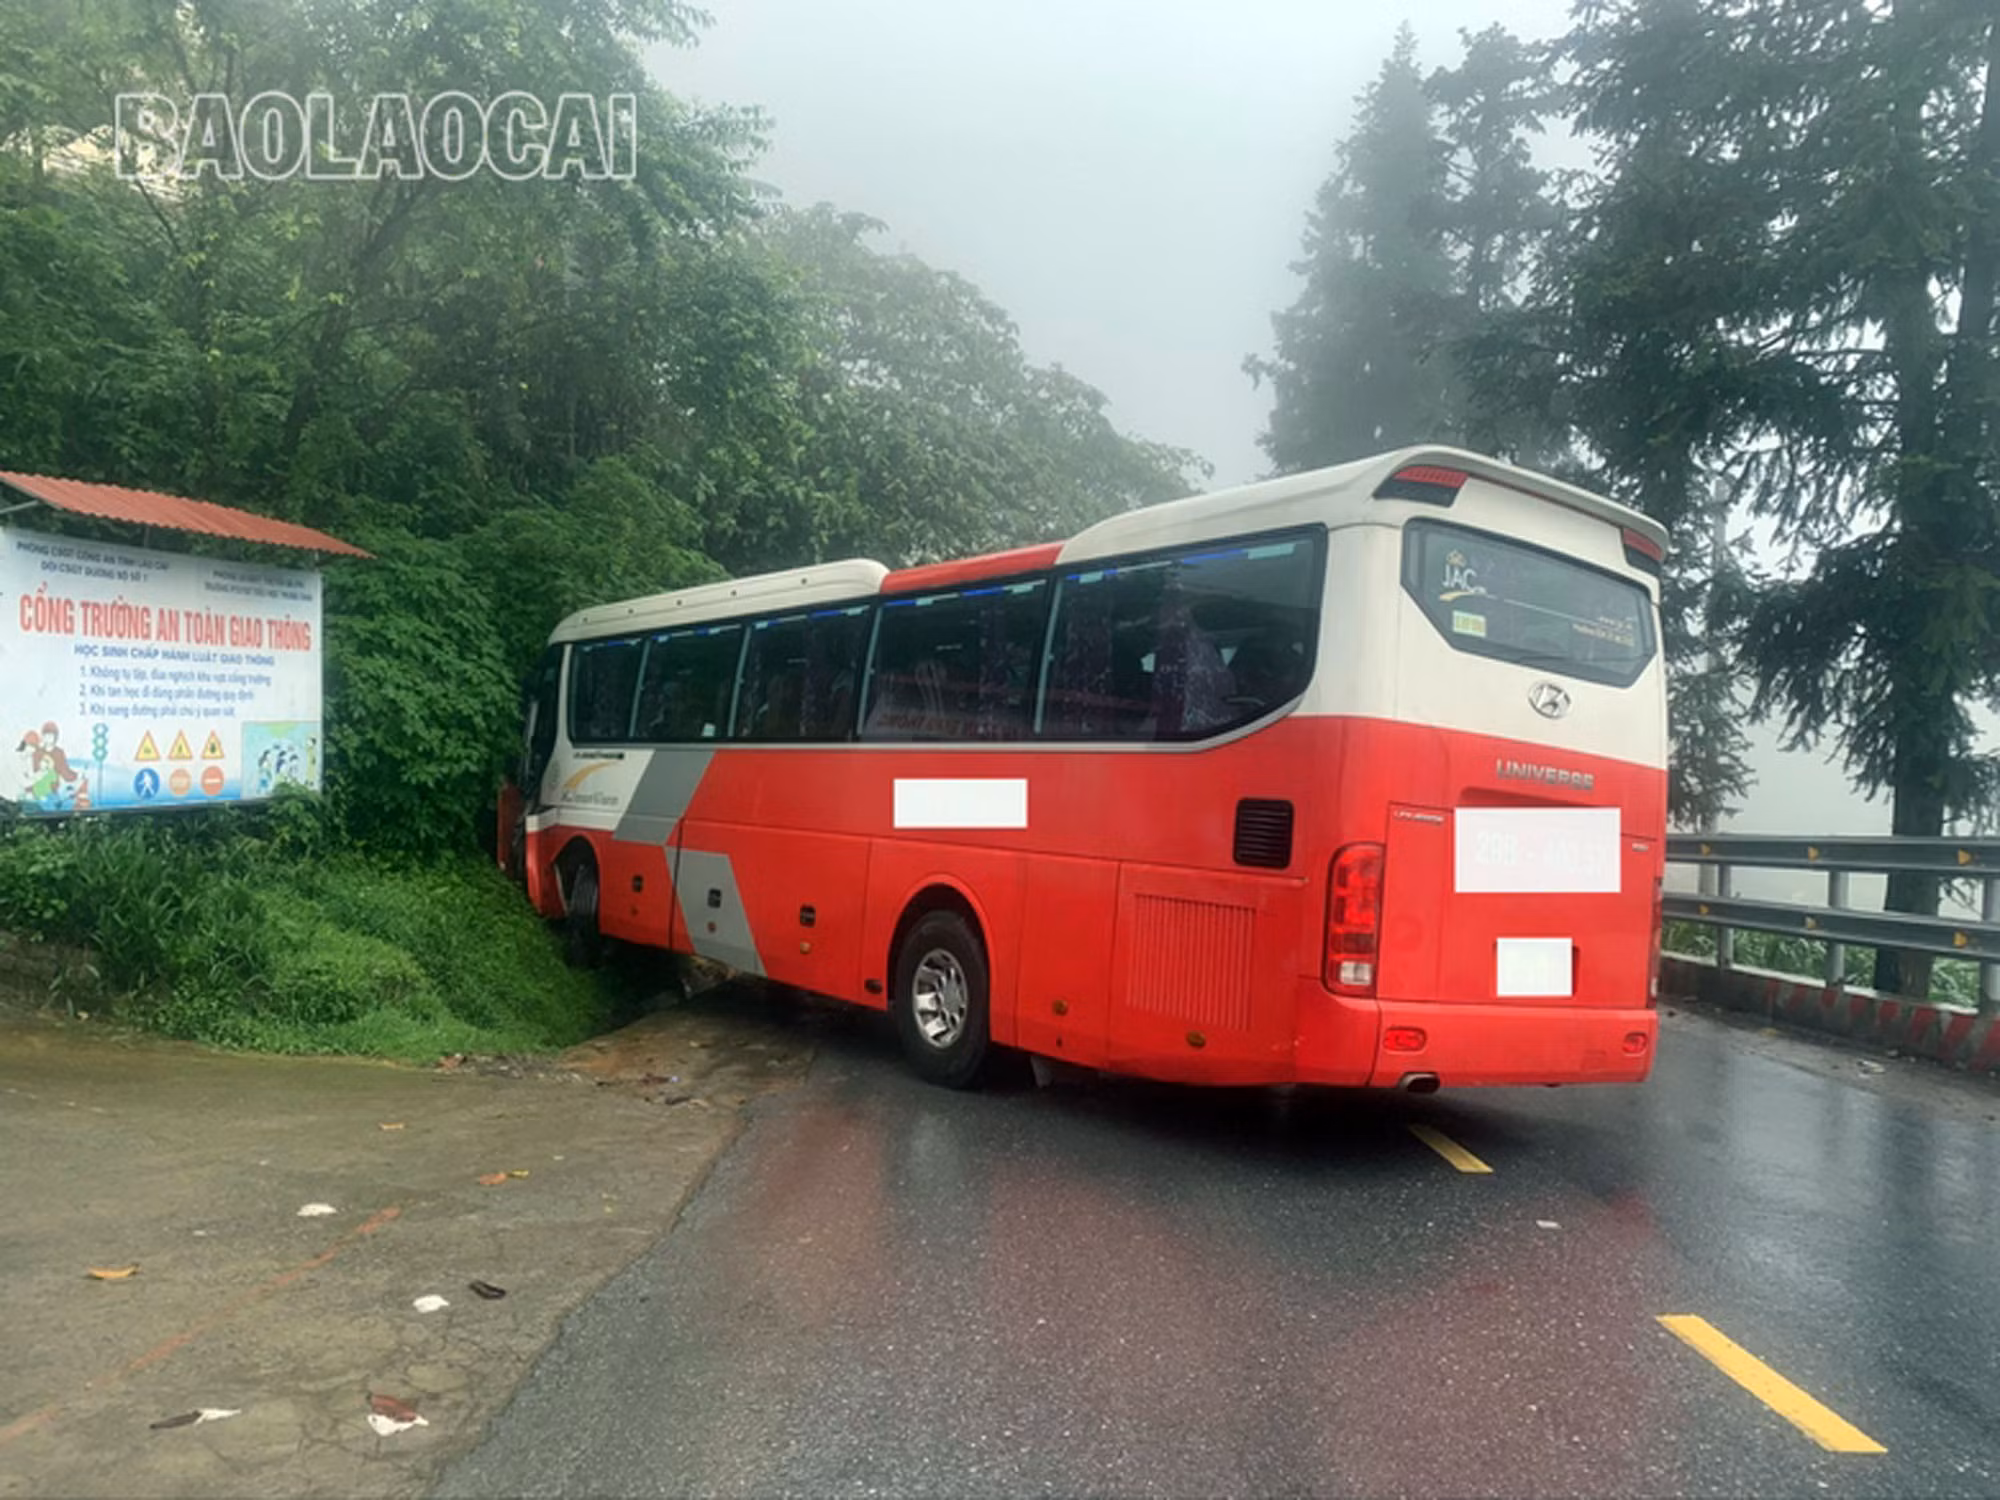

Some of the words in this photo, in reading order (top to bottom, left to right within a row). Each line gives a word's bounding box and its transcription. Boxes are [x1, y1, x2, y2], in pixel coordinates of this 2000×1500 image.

[1441, 563, 1478, 590] JAC
[20, 581, 75, 634] CỔNG
[80, 594, 151, 640] TRƯỜNG
[156, 607, 180, 643] AN
[184, 604, 226, 647] TOÀN
[229, 613, 263, 649] GIAO
[267, 613, 311, 652] THÔNG
[74, 644, 99, 659] HỌC
[102, 645, 128, 657] SINH
[220, 653, 243, 665] GIAO
[1496, 758, 1595, 791] UNIVERSE
